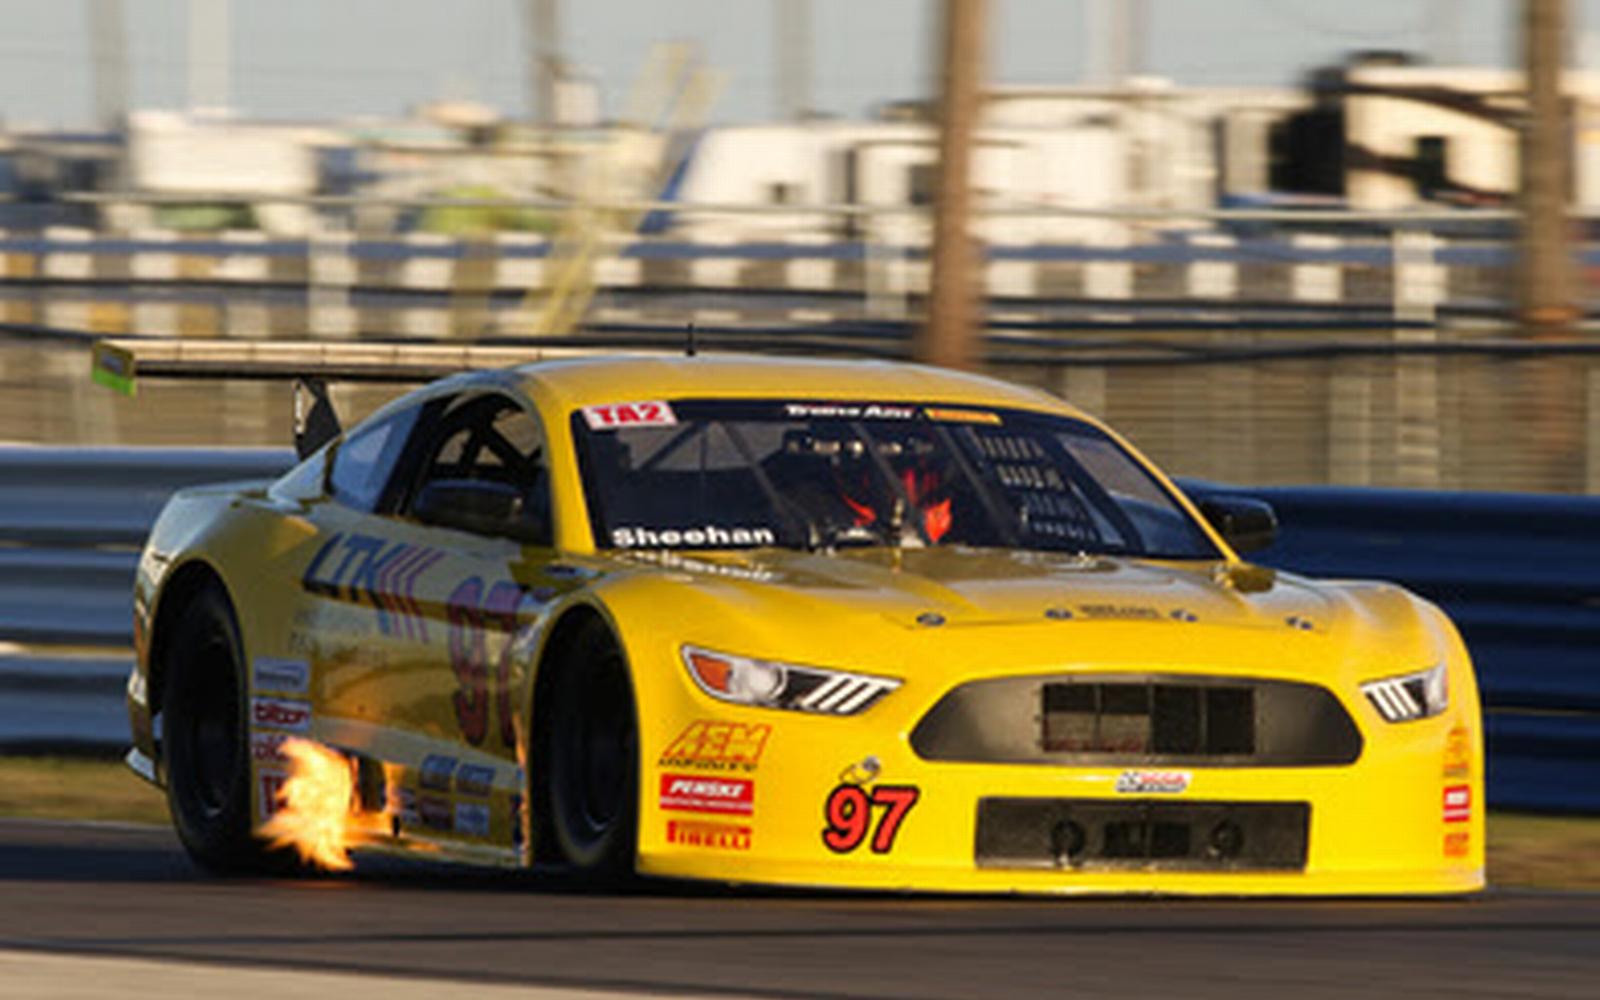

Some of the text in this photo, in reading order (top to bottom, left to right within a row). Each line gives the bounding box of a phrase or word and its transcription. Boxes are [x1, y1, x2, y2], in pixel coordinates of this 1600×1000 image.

[592, 404, 665, 424] TA2
[612, 526, 775, 547] Sheehan
[669, 780, 746, 798] PENSKE
[822, 783, 920, 854] 97
[666, 819, 752, 850] PIRELLI
